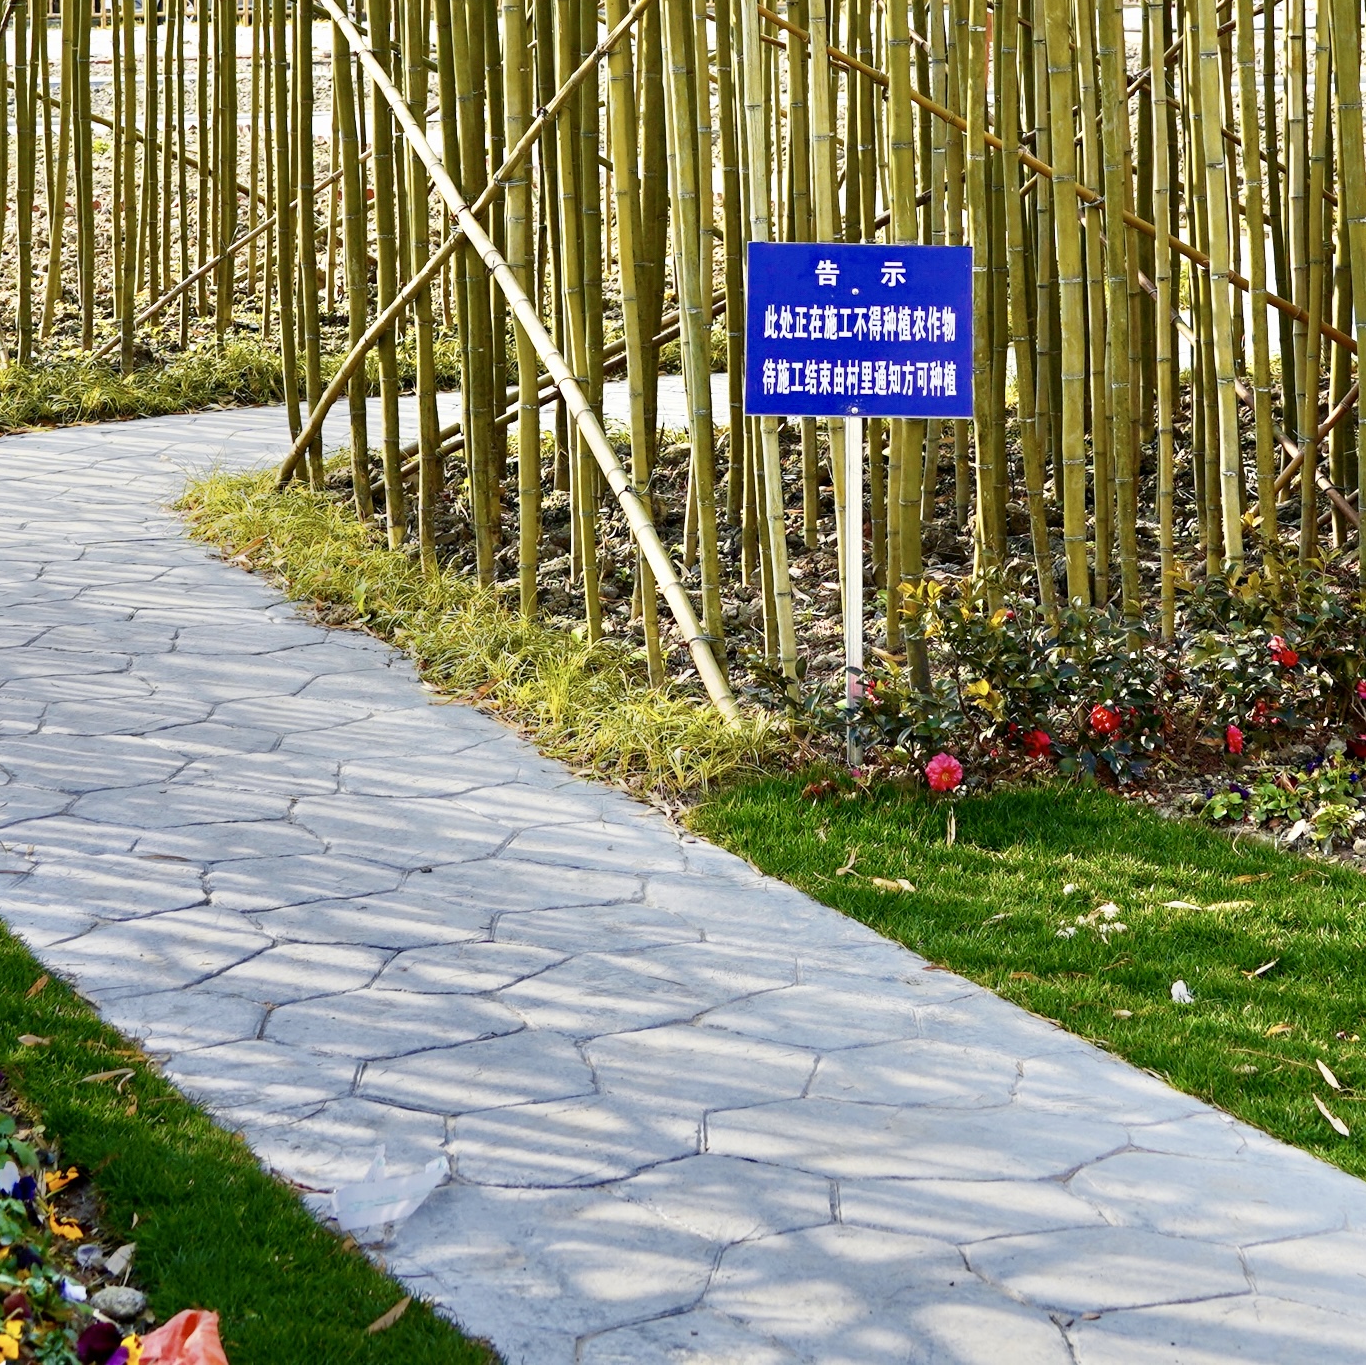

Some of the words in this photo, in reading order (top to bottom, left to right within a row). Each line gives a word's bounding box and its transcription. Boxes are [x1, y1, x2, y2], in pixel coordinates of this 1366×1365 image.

[814, 259, 907, 287] 告示
[763, 304, 956, 343] 此处正在施工不得种植农作物
[762, 358, 957, 397] 待施工结束由村里通知方可种植
